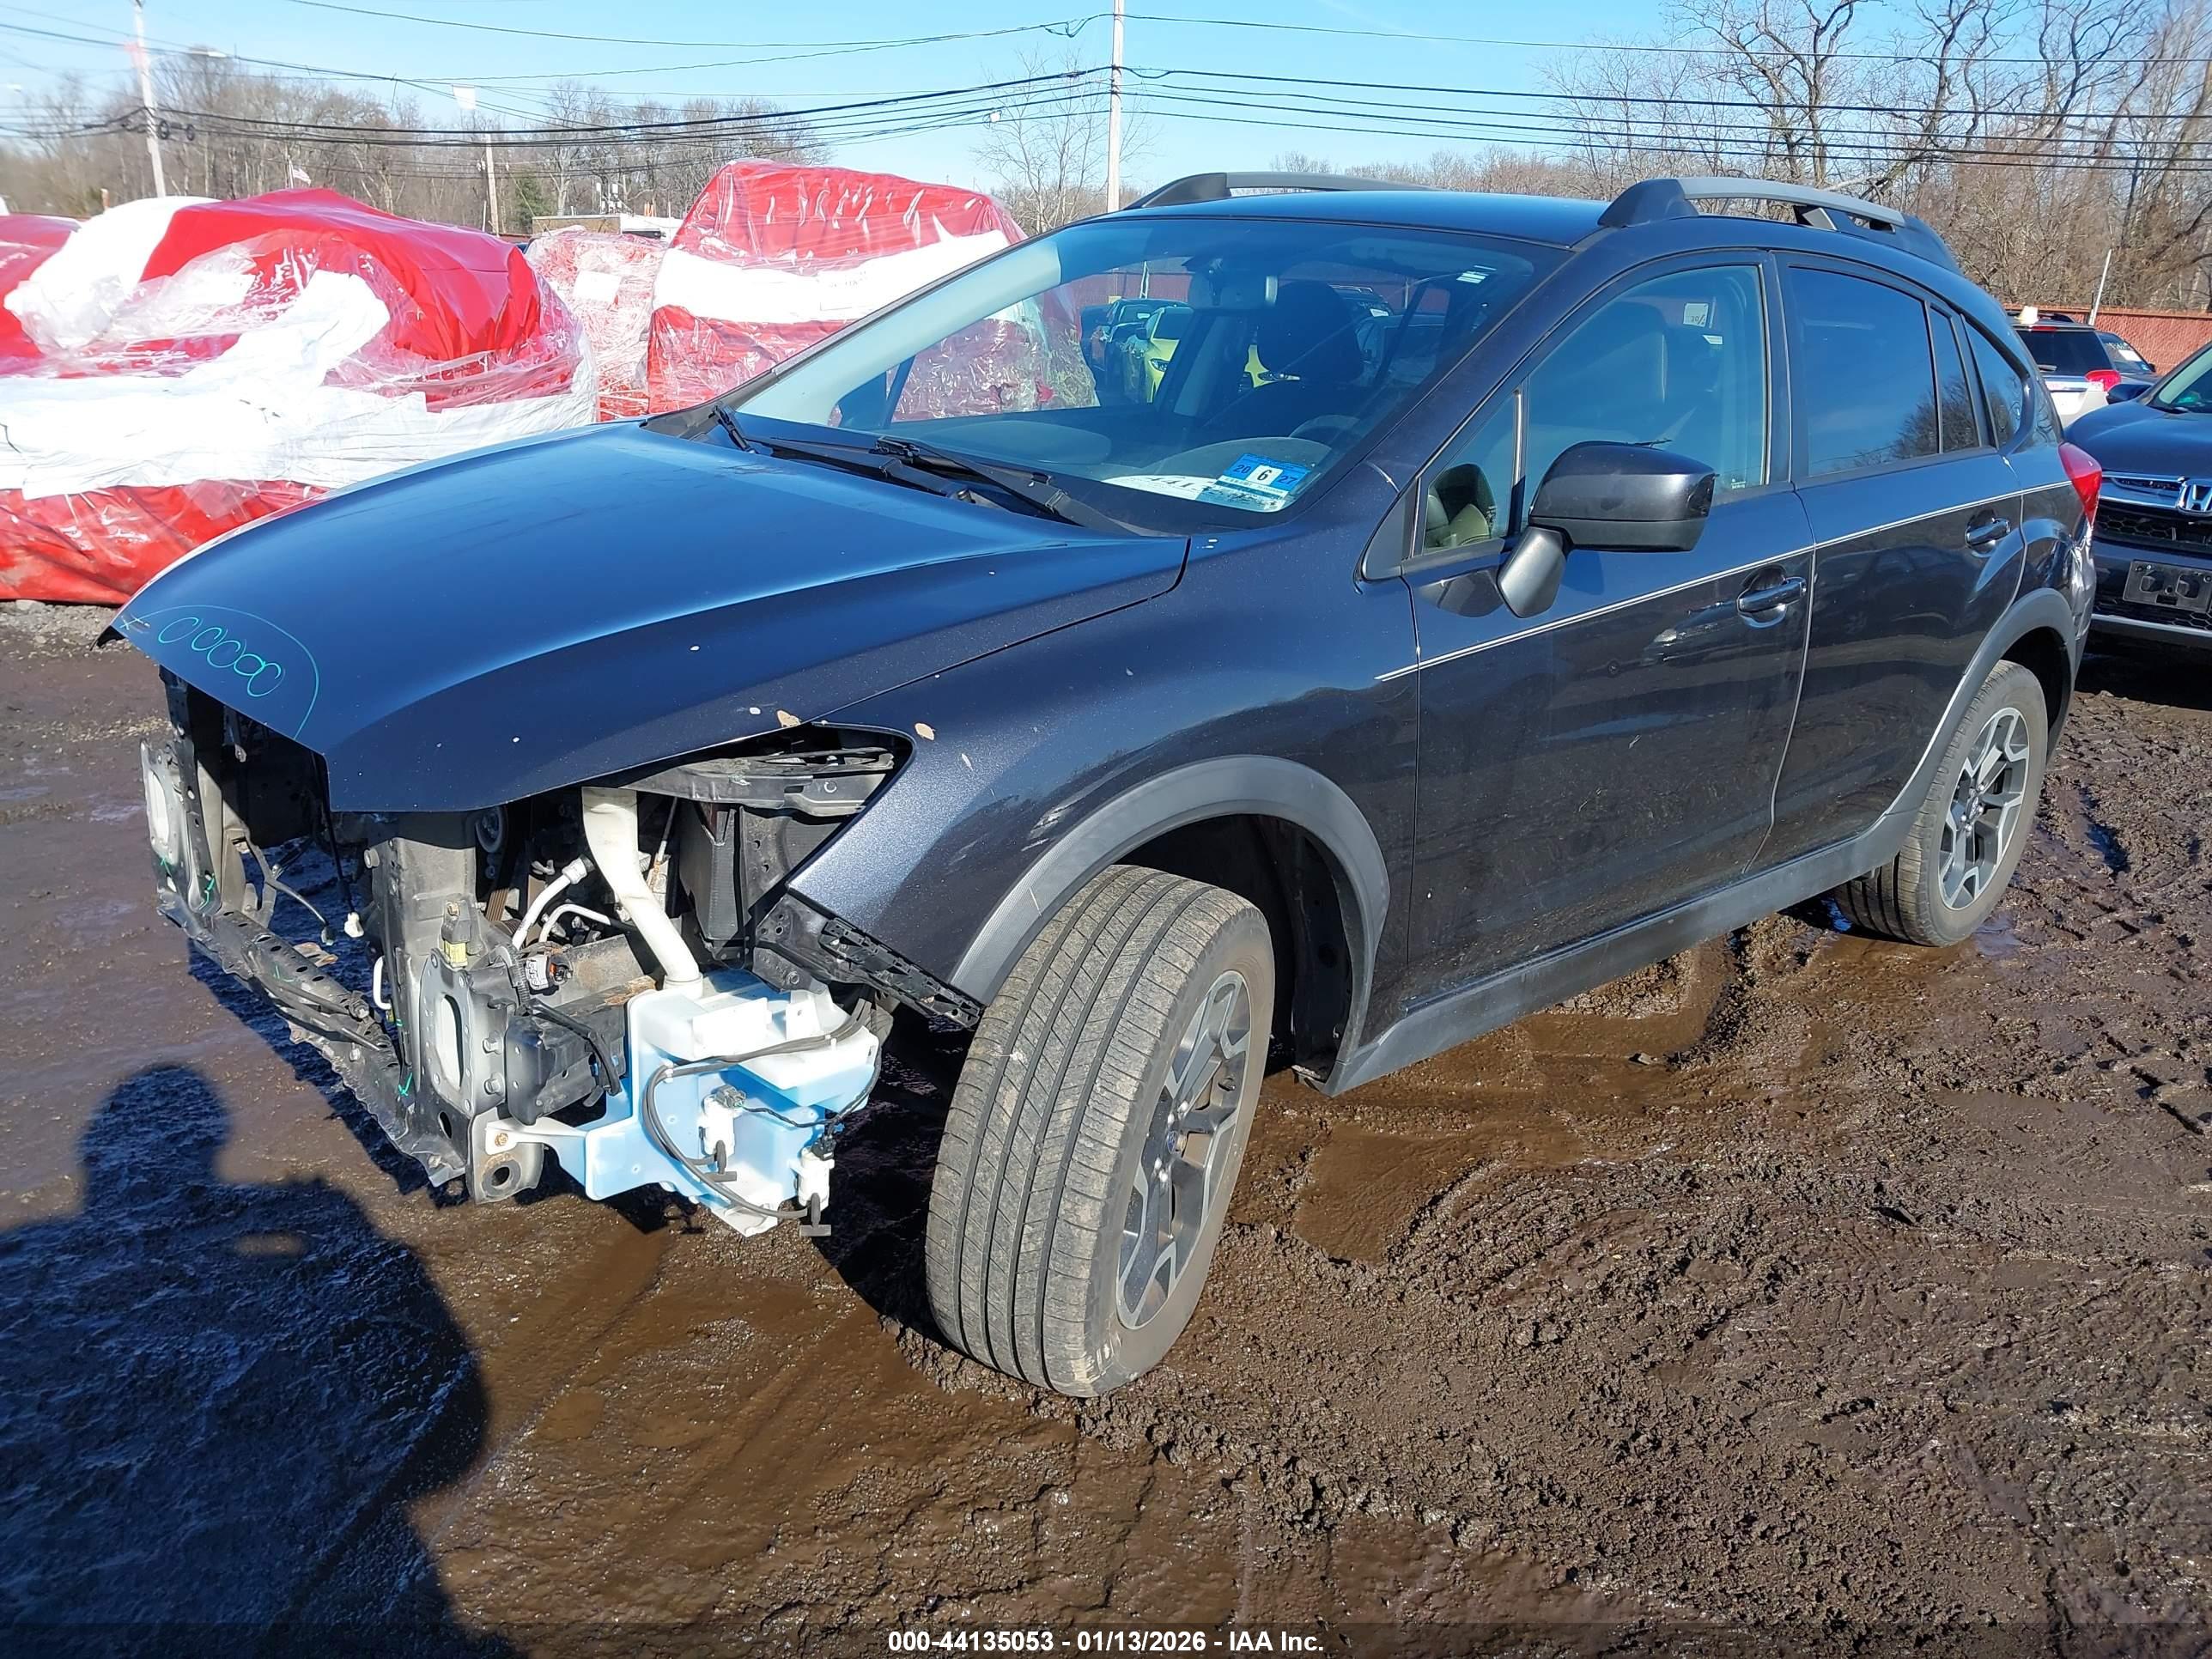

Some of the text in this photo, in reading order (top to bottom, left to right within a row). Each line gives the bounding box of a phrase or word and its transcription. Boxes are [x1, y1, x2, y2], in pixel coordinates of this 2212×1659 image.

[1232, 464, 1298, 485] 20 6 27
